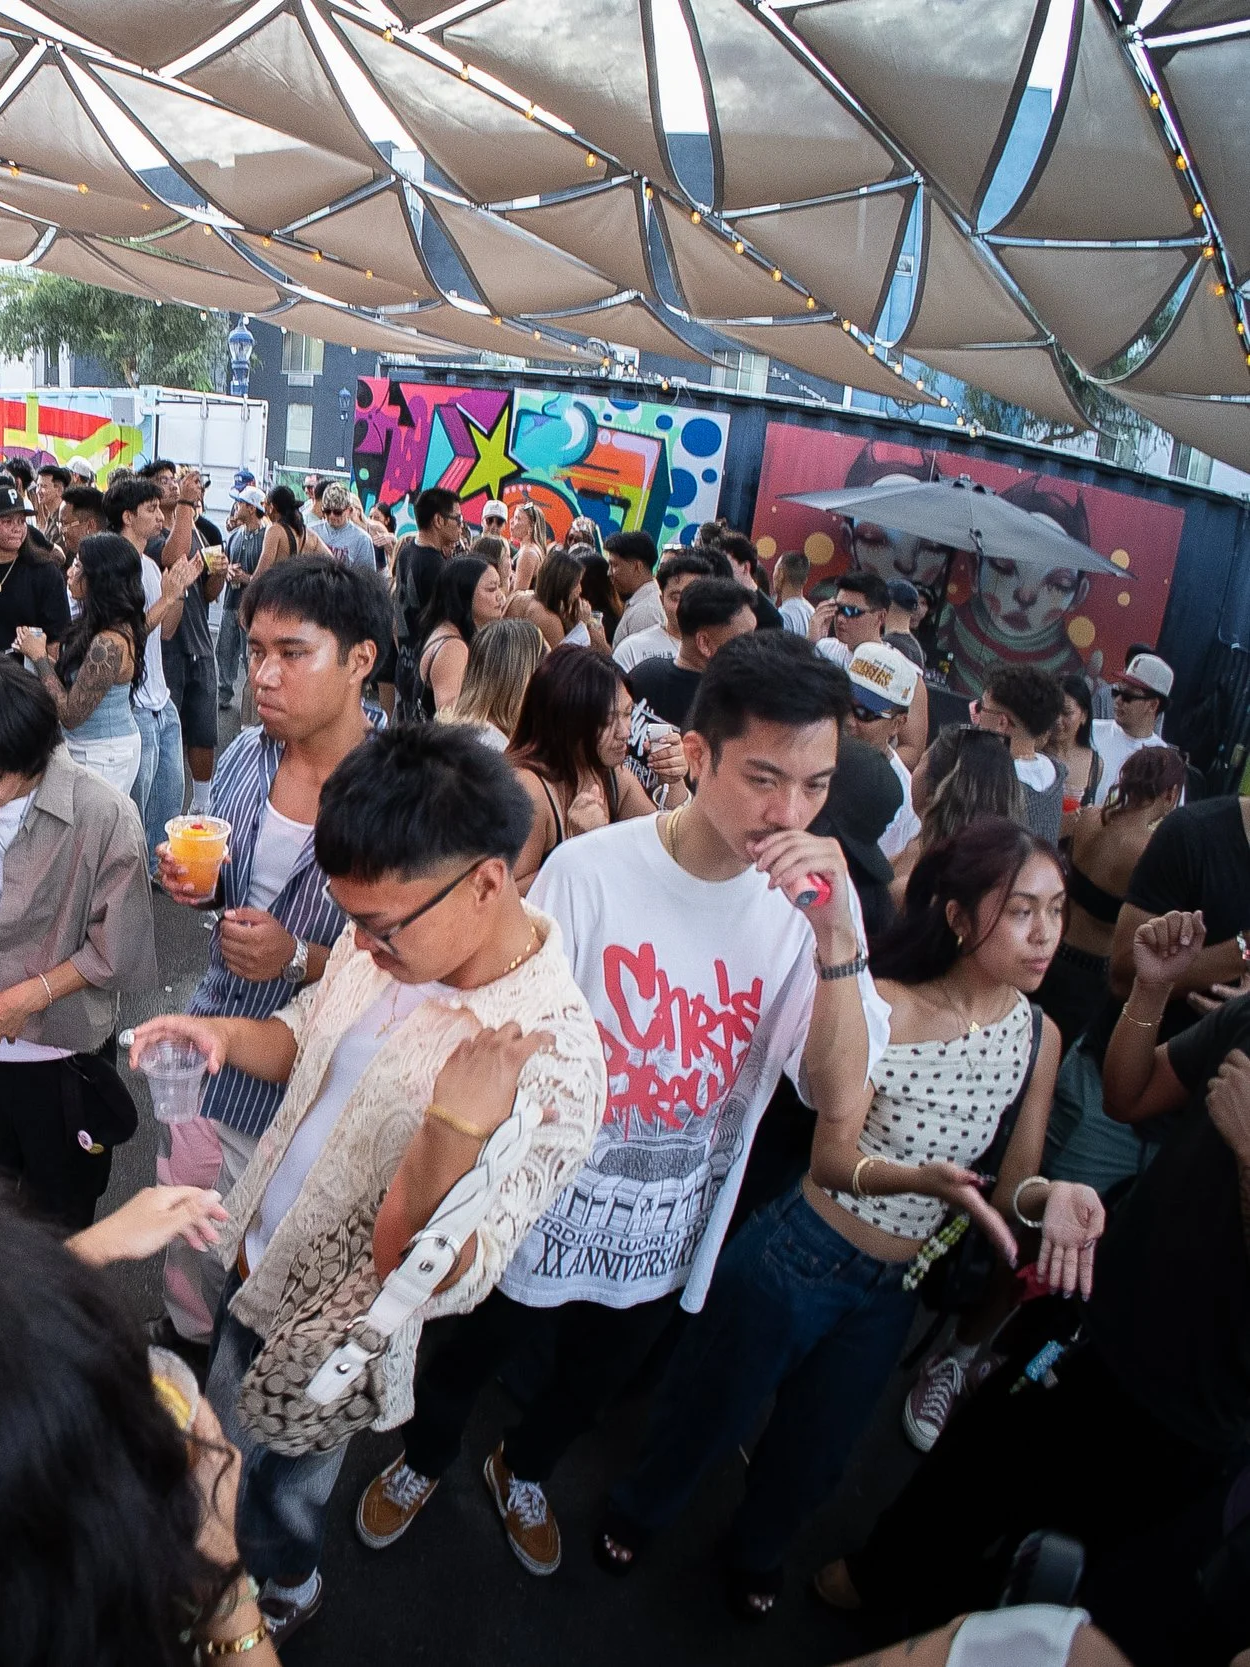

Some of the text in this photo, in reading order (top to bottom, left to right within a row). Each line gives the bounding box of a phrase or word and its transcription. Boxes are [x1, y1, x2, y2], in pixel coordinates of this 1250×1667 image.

[531, 1232, 704, 1281] XX ANNIVERSARY
[619, 1229, 680, 1252] WORLD
